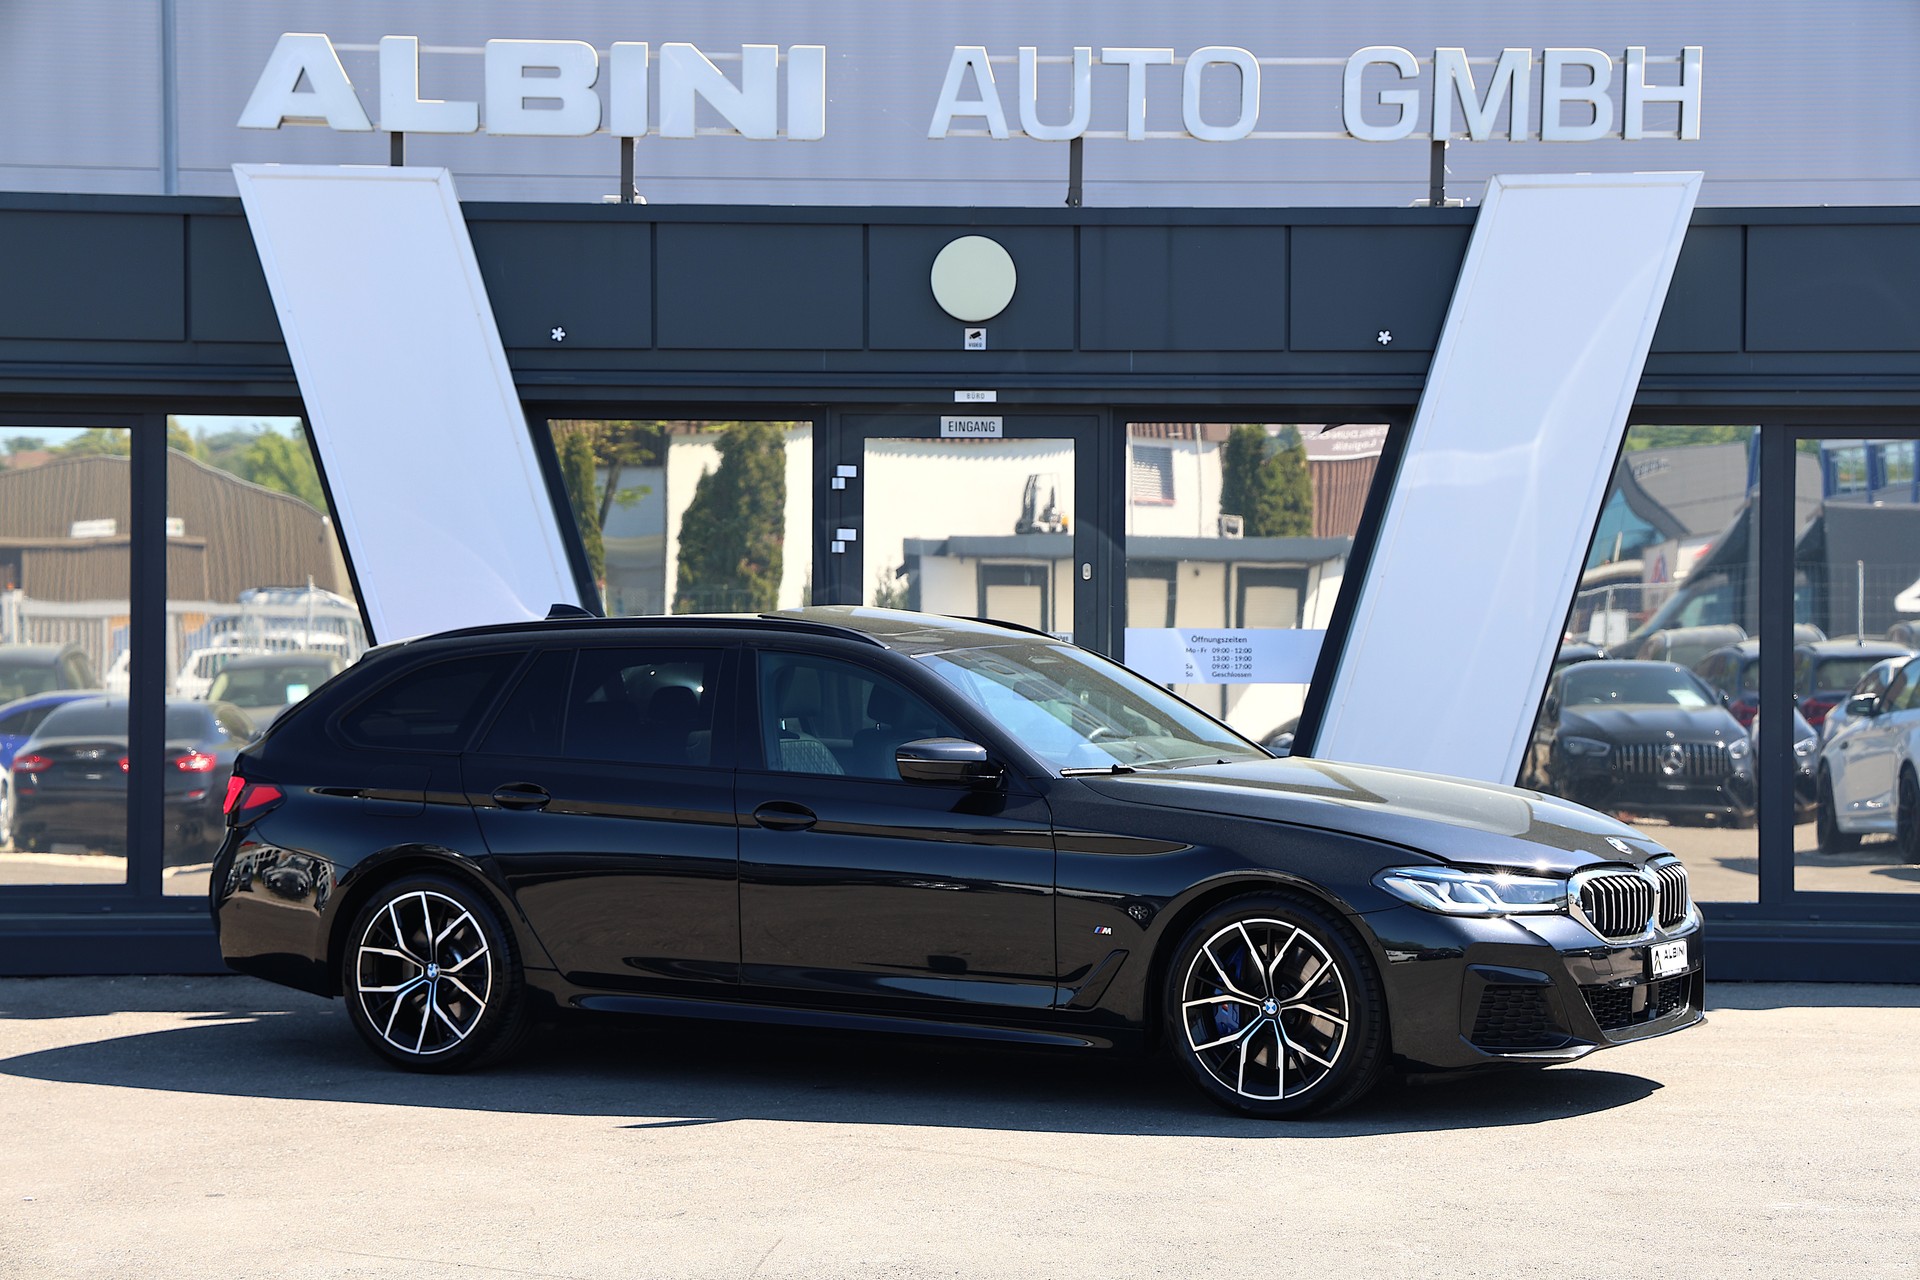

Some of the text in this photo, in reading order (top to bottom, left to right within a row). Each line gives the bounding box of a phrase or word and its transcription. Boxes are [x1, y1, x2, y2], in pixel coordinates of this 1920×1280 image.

[236, 32, 1703, 143] ALBINI AUTO GMBH
[966, 392, 985, 400] BÜRO
[948, 421, 996, 433] EINGANG
[1191, 635, 1247, 644] Öffnungszeiten
